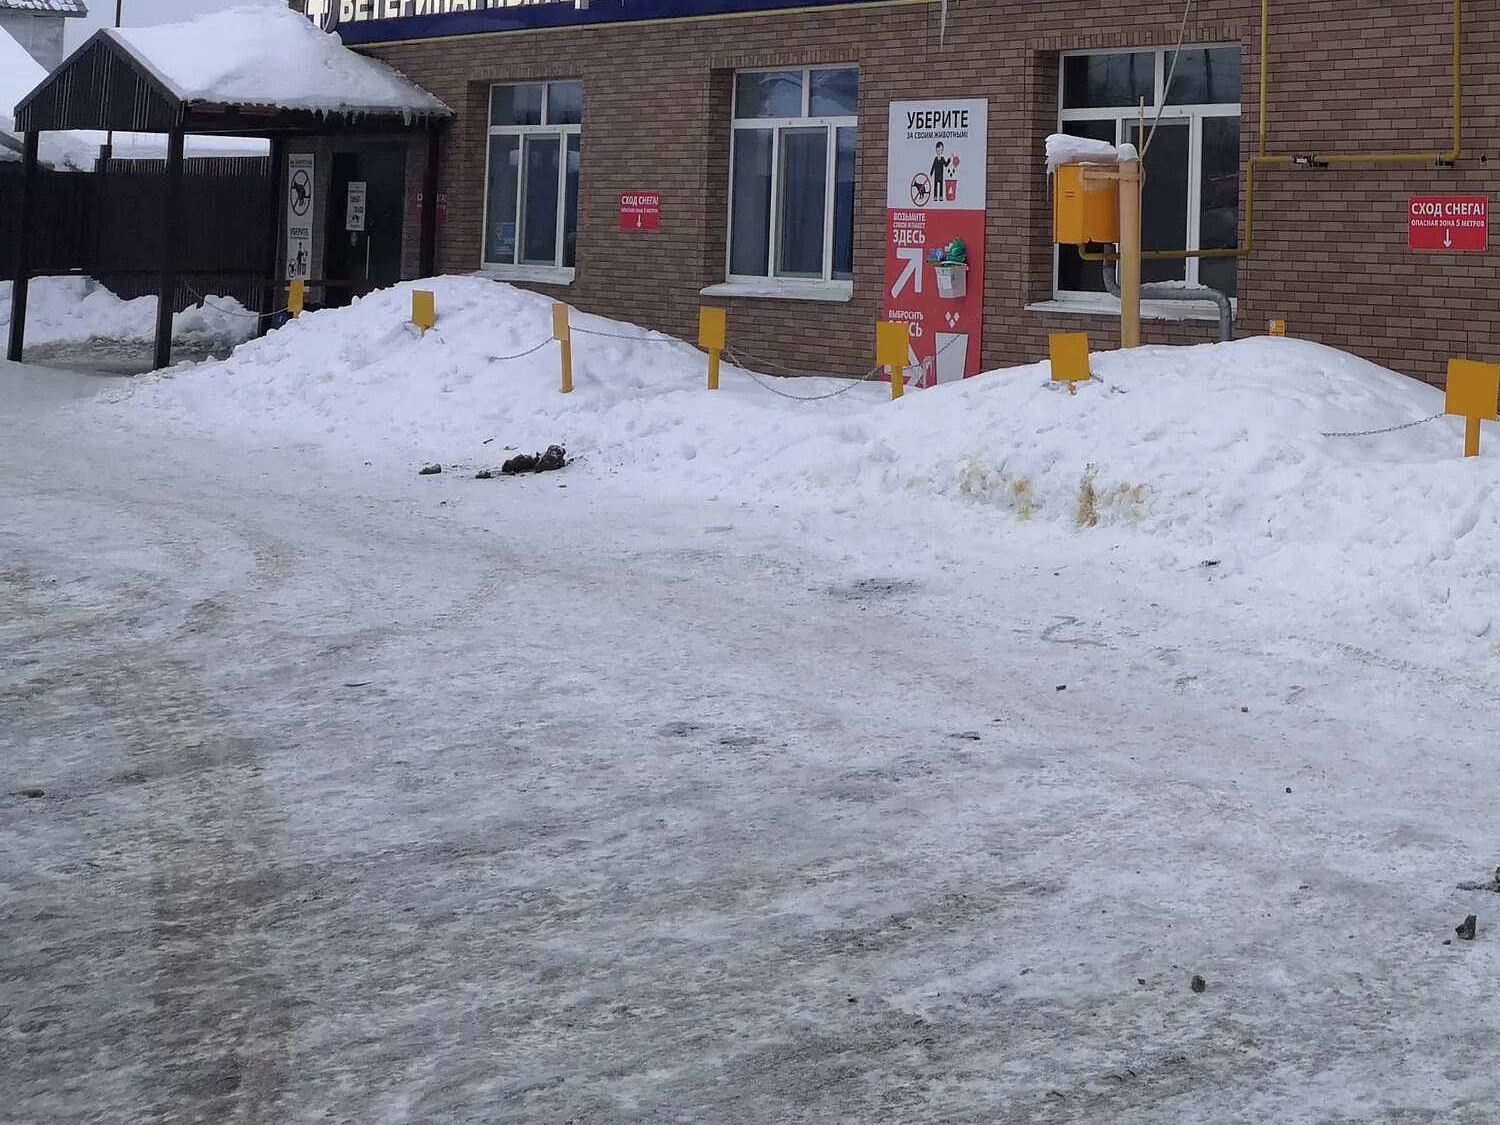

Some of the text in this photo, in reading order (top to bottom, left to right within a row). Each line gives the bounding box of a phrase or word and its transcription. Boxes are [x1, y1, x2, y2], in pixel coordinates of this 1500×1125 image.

[906, 110, 969, 130] УБЕРИТЕ
[907, 131, 914, 139] ЗА
[914, 131, 934, 139] СВОИМ
[621, 195, 659, 206] СХОД СНЕГА!
[1411, 202, 1485, 217] СХОД СНЕГА!
[893, 212, 926, 222] ВОЗЬМИТЕ
[1411, 219, 1439, 227] ОПАСНАЯ
[1439, 219, 1455, 227] ЗОНА
[1455, 219, 1461, 227] 5
[893, 229, 926, 246] ЗДЕСЬ
[889, 309, 924, 321] ВЫБРОСИТЬ
